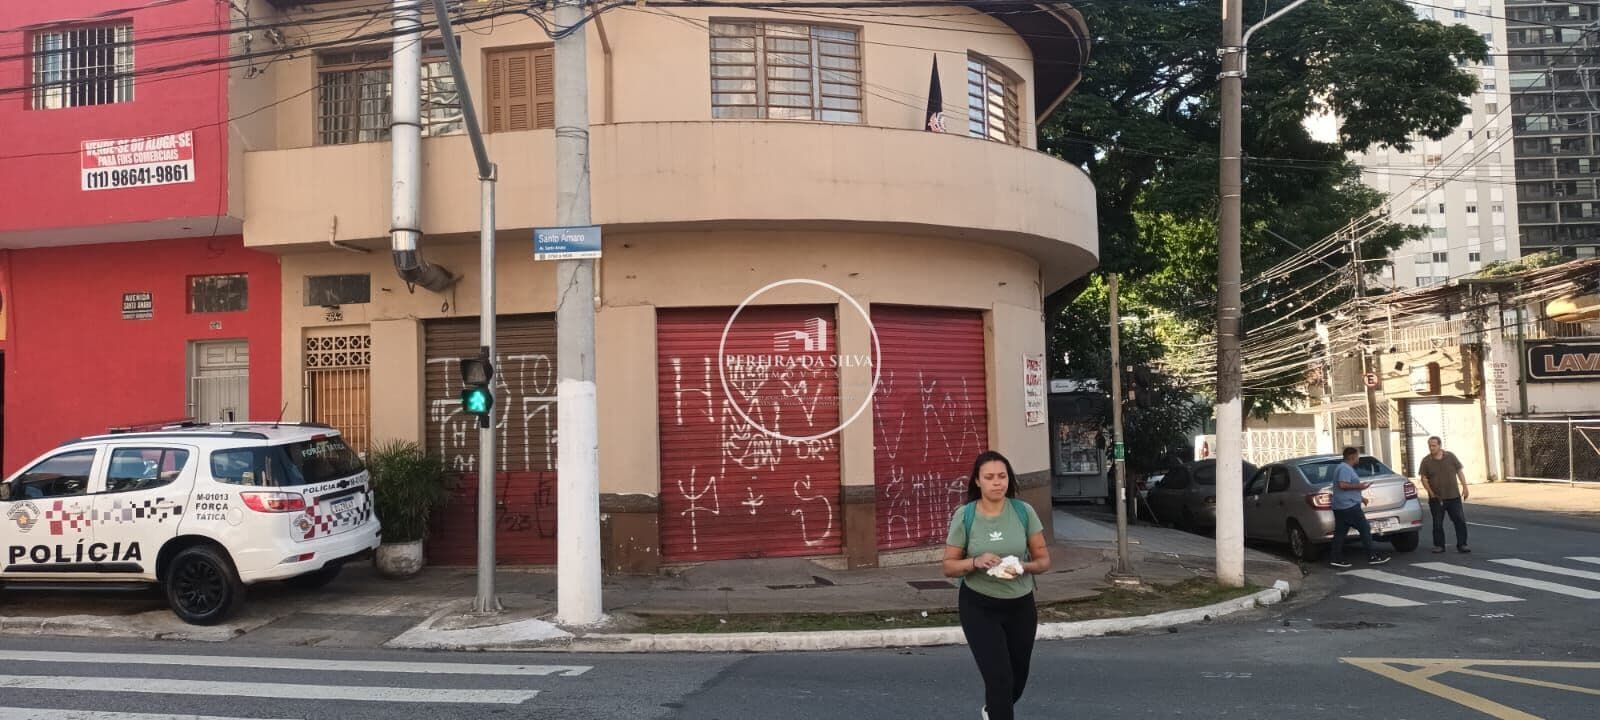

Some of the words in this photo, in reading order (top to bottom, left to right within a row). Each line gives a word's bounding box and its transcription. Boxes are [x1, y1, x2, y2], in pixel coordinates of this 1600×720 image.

[86, 139, 129, 156] VENDE-SE
[130, 138, 145, 151] OU
[144, 132, 191, 151] ALUGA-SE
[98, 155, 117, 167] PARA
[117, 153, 133, 165] FINS
[133, 149, 179, 163] COMERCIAIS
[87, 171, 108, 188] (11)
[111, 164, 189, 187] 98641-9861
[538, 233, 560, 243] Santo
[560, 233, 585, 243] Amaro
[303, 482, 336, 494] POLÍCIA
[196, 493, 229, 501] M-01013
[195, 502, 229, 512] FORÇA
[9, 538, 142, 564] POLÍCIA
